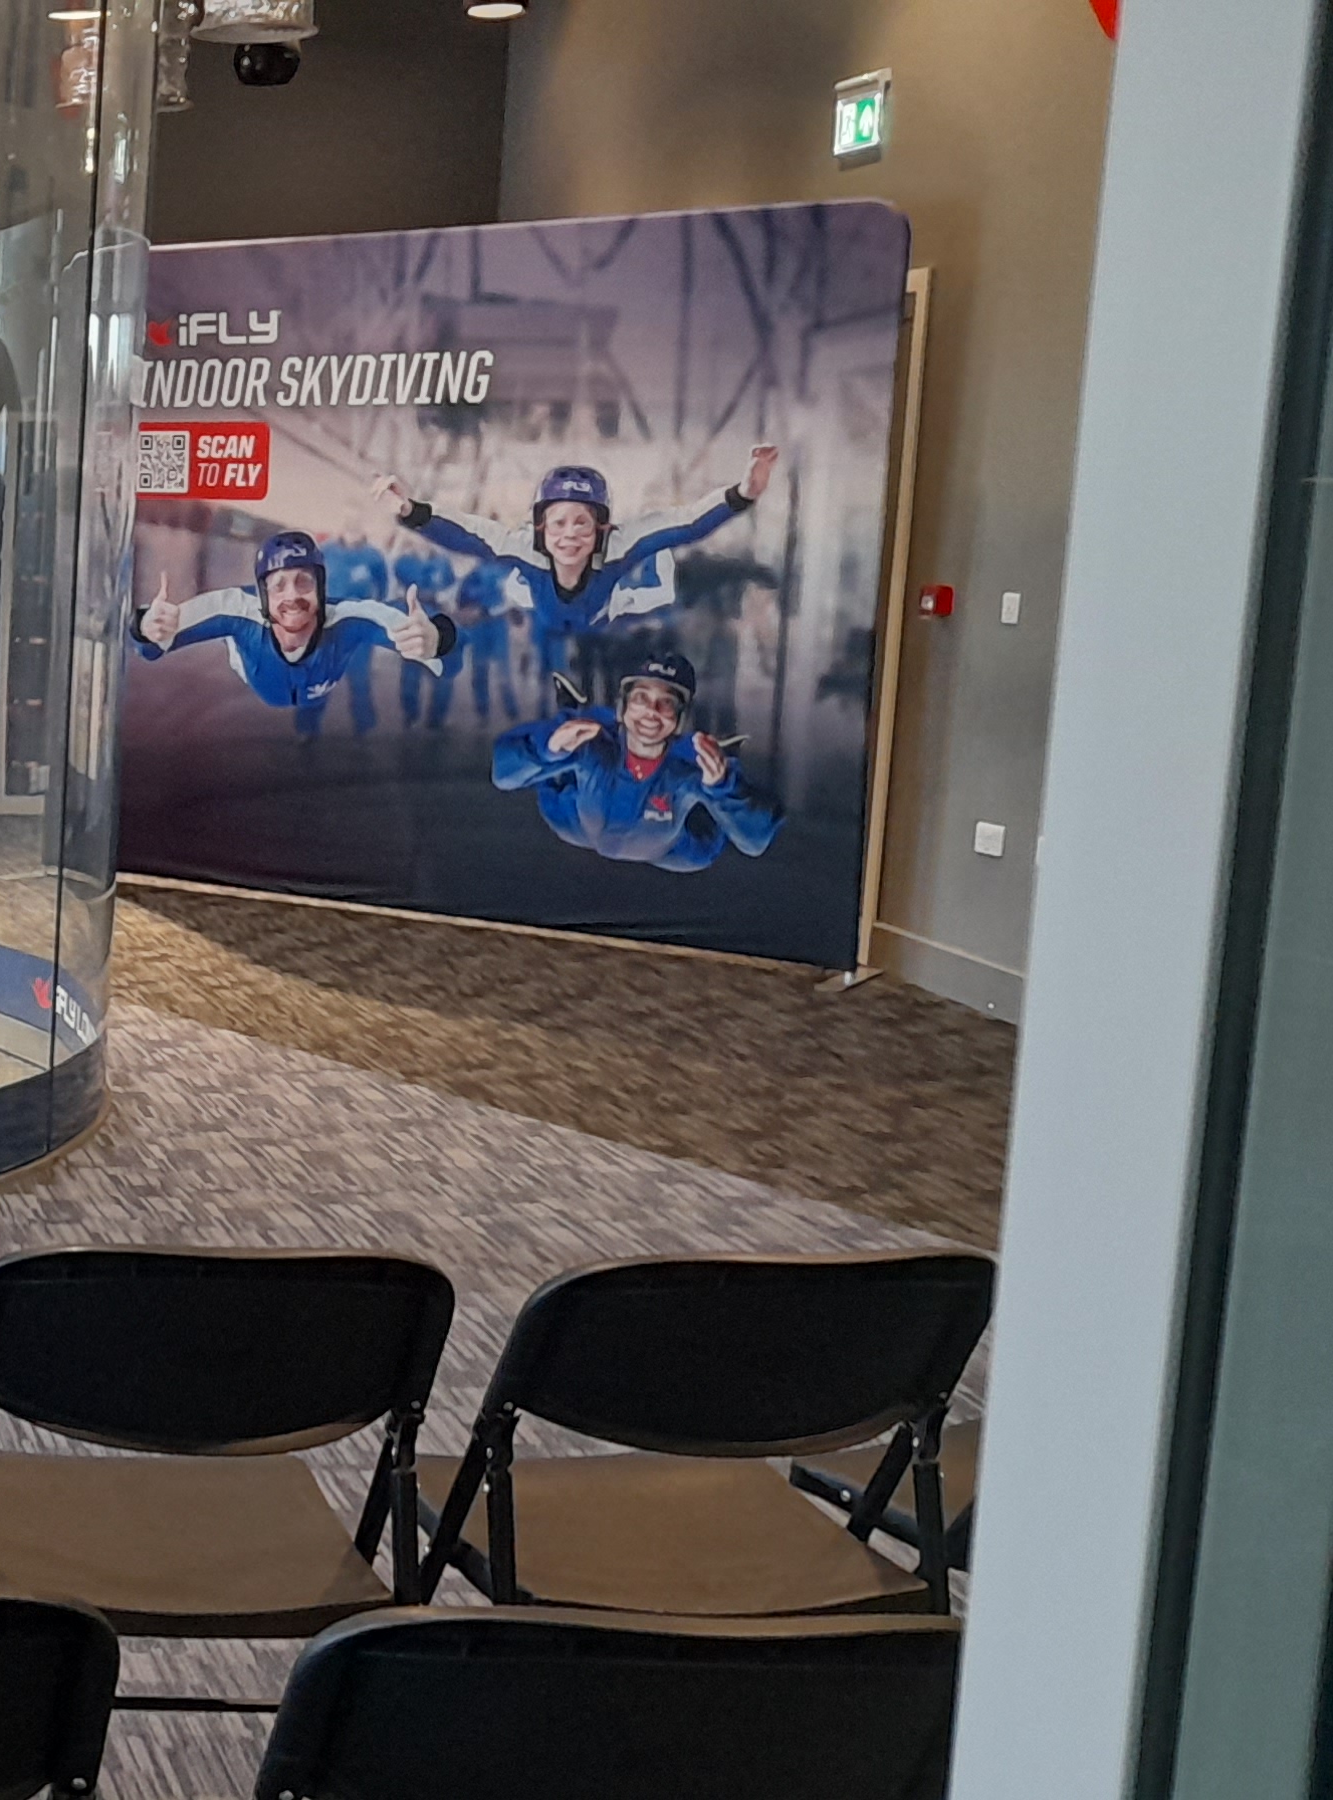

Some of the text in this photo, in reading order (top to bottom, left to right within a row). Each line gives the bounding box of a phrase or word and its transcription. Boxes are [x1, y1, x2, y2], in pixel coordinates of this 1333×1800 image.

[178, 309, 282, 347] iFLY
[140, 350, 494, 409] INDOOR SKYDIVING
[197, 436, 254, 459] SCAN
[198, 463, 263, 488] TO FLY
